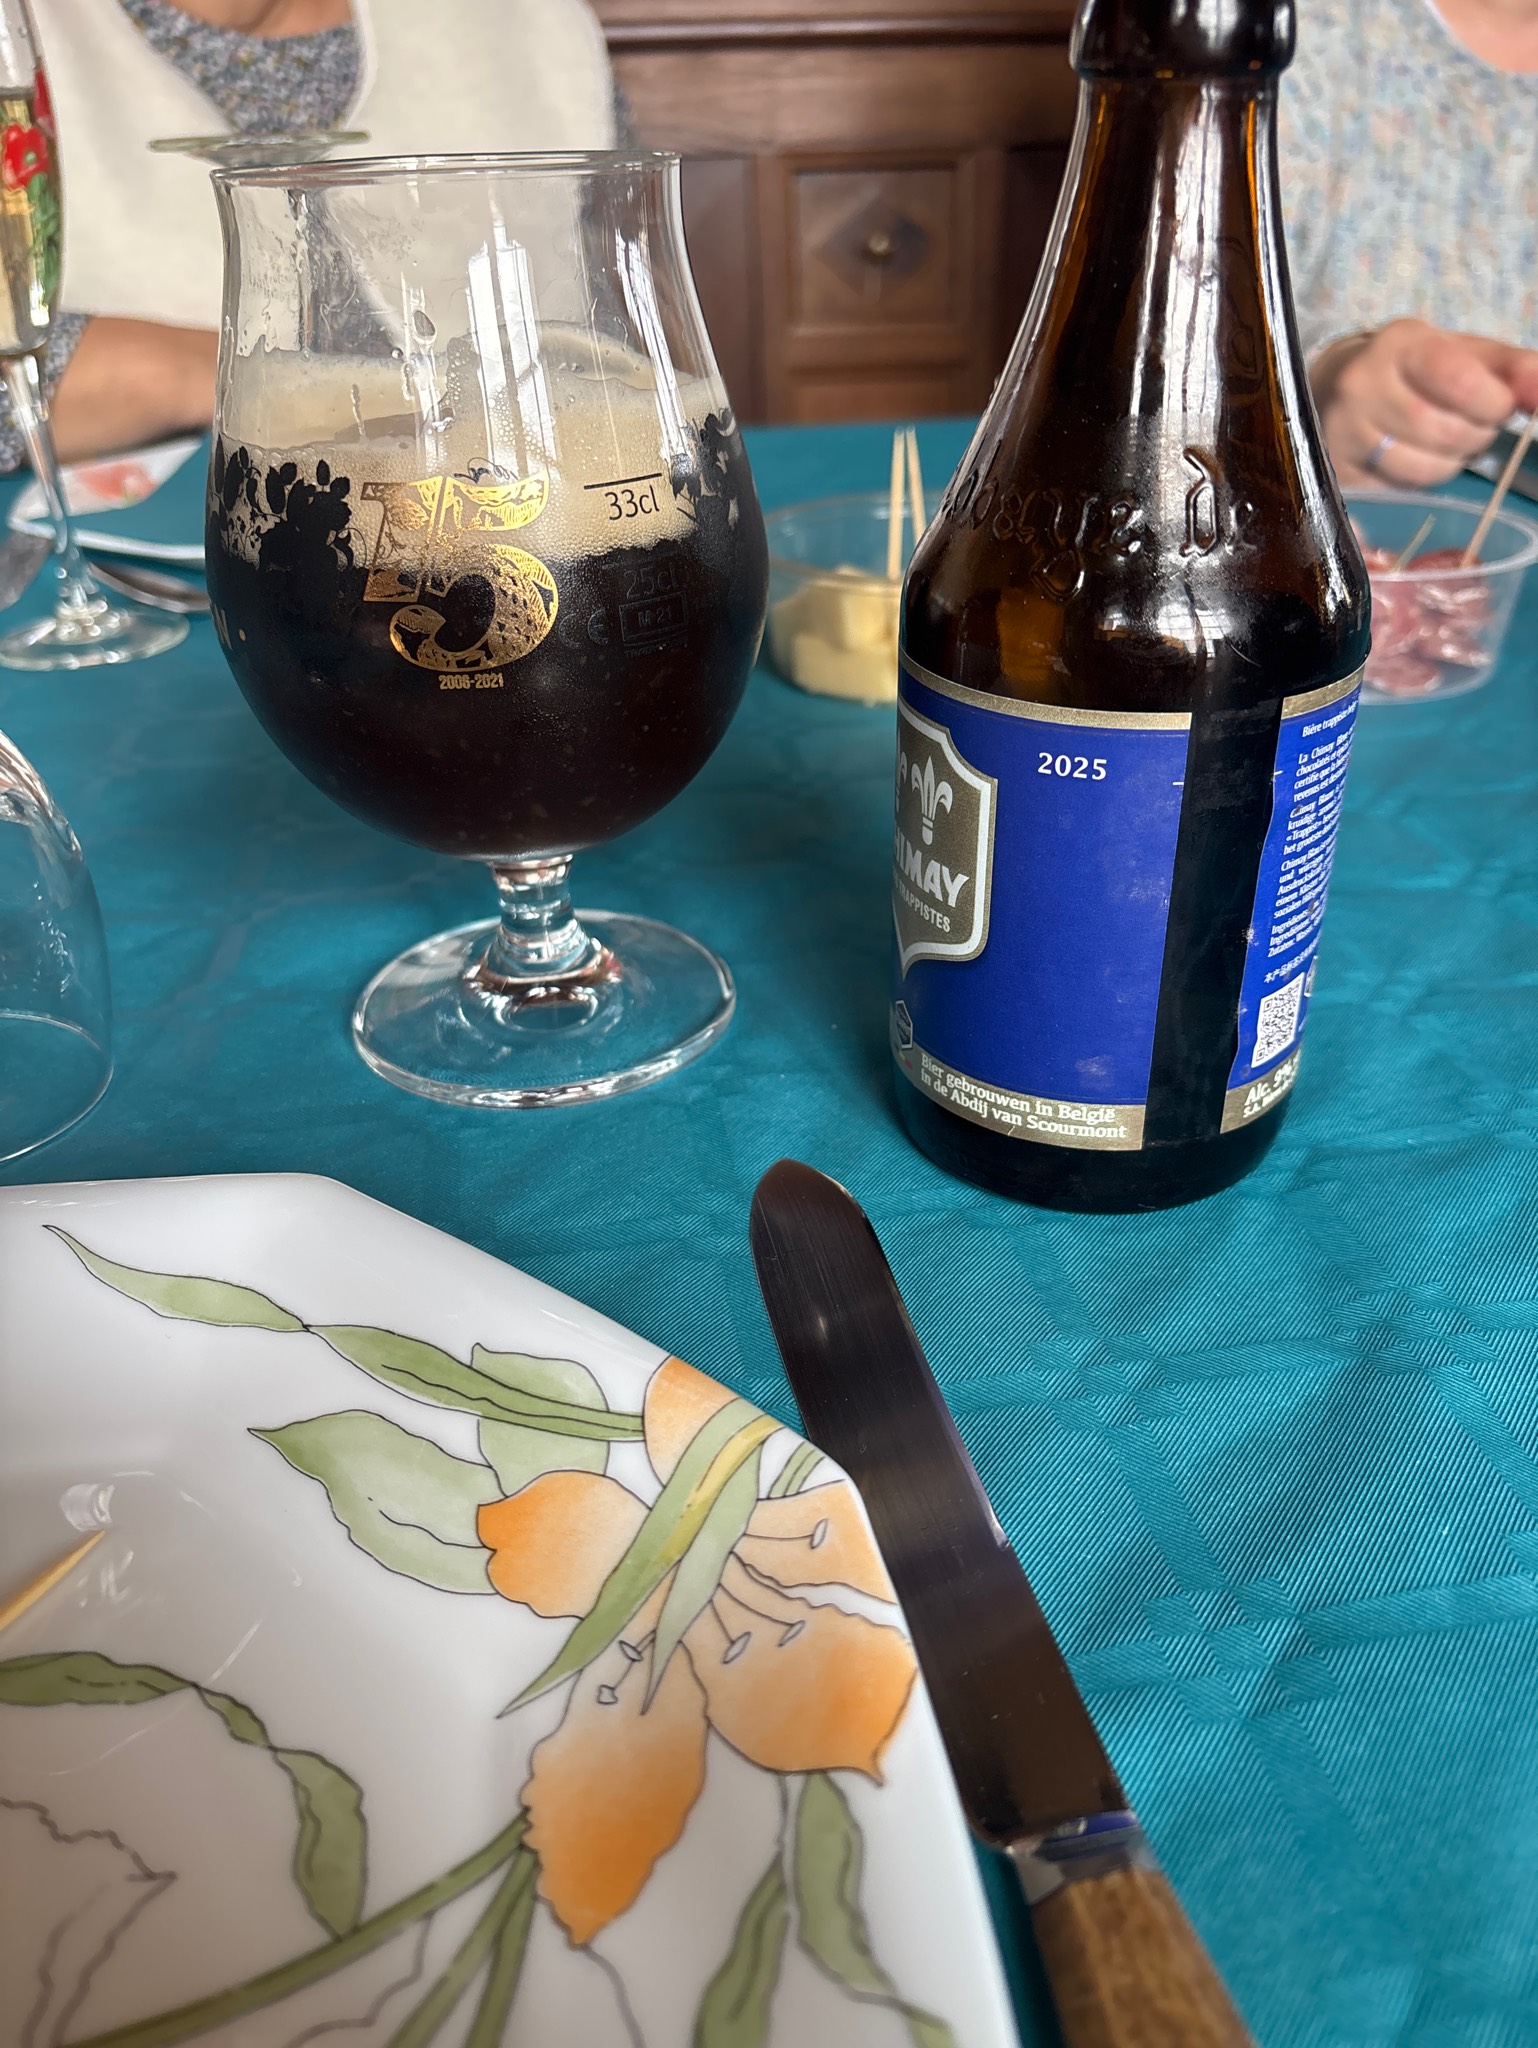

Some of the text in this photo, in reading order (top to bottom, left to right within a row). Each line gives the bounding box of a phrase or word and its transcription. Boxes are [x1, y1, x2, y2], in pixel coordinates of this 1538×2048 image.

[604, 486, 661, 521] 33cl
[623, 561, 679, 600] 25cl
[438, 672, 505, 690] 2006-2021
[1302, 723, 1322, 738] Bière
[1036, 752, 1109, 781] 2025
[1298, 753, 1309, 765] La
[1311, 741, 1335, 760] Chimay
[894, 823, 971, 909] HIMAY
[899, 877, 951, 933] TRAPPISTES
[920, 1052, 1117, 1126] Bier gebrouwen in België
[920, 1068, 1128, 1139] in de Abdij van Scourmont
